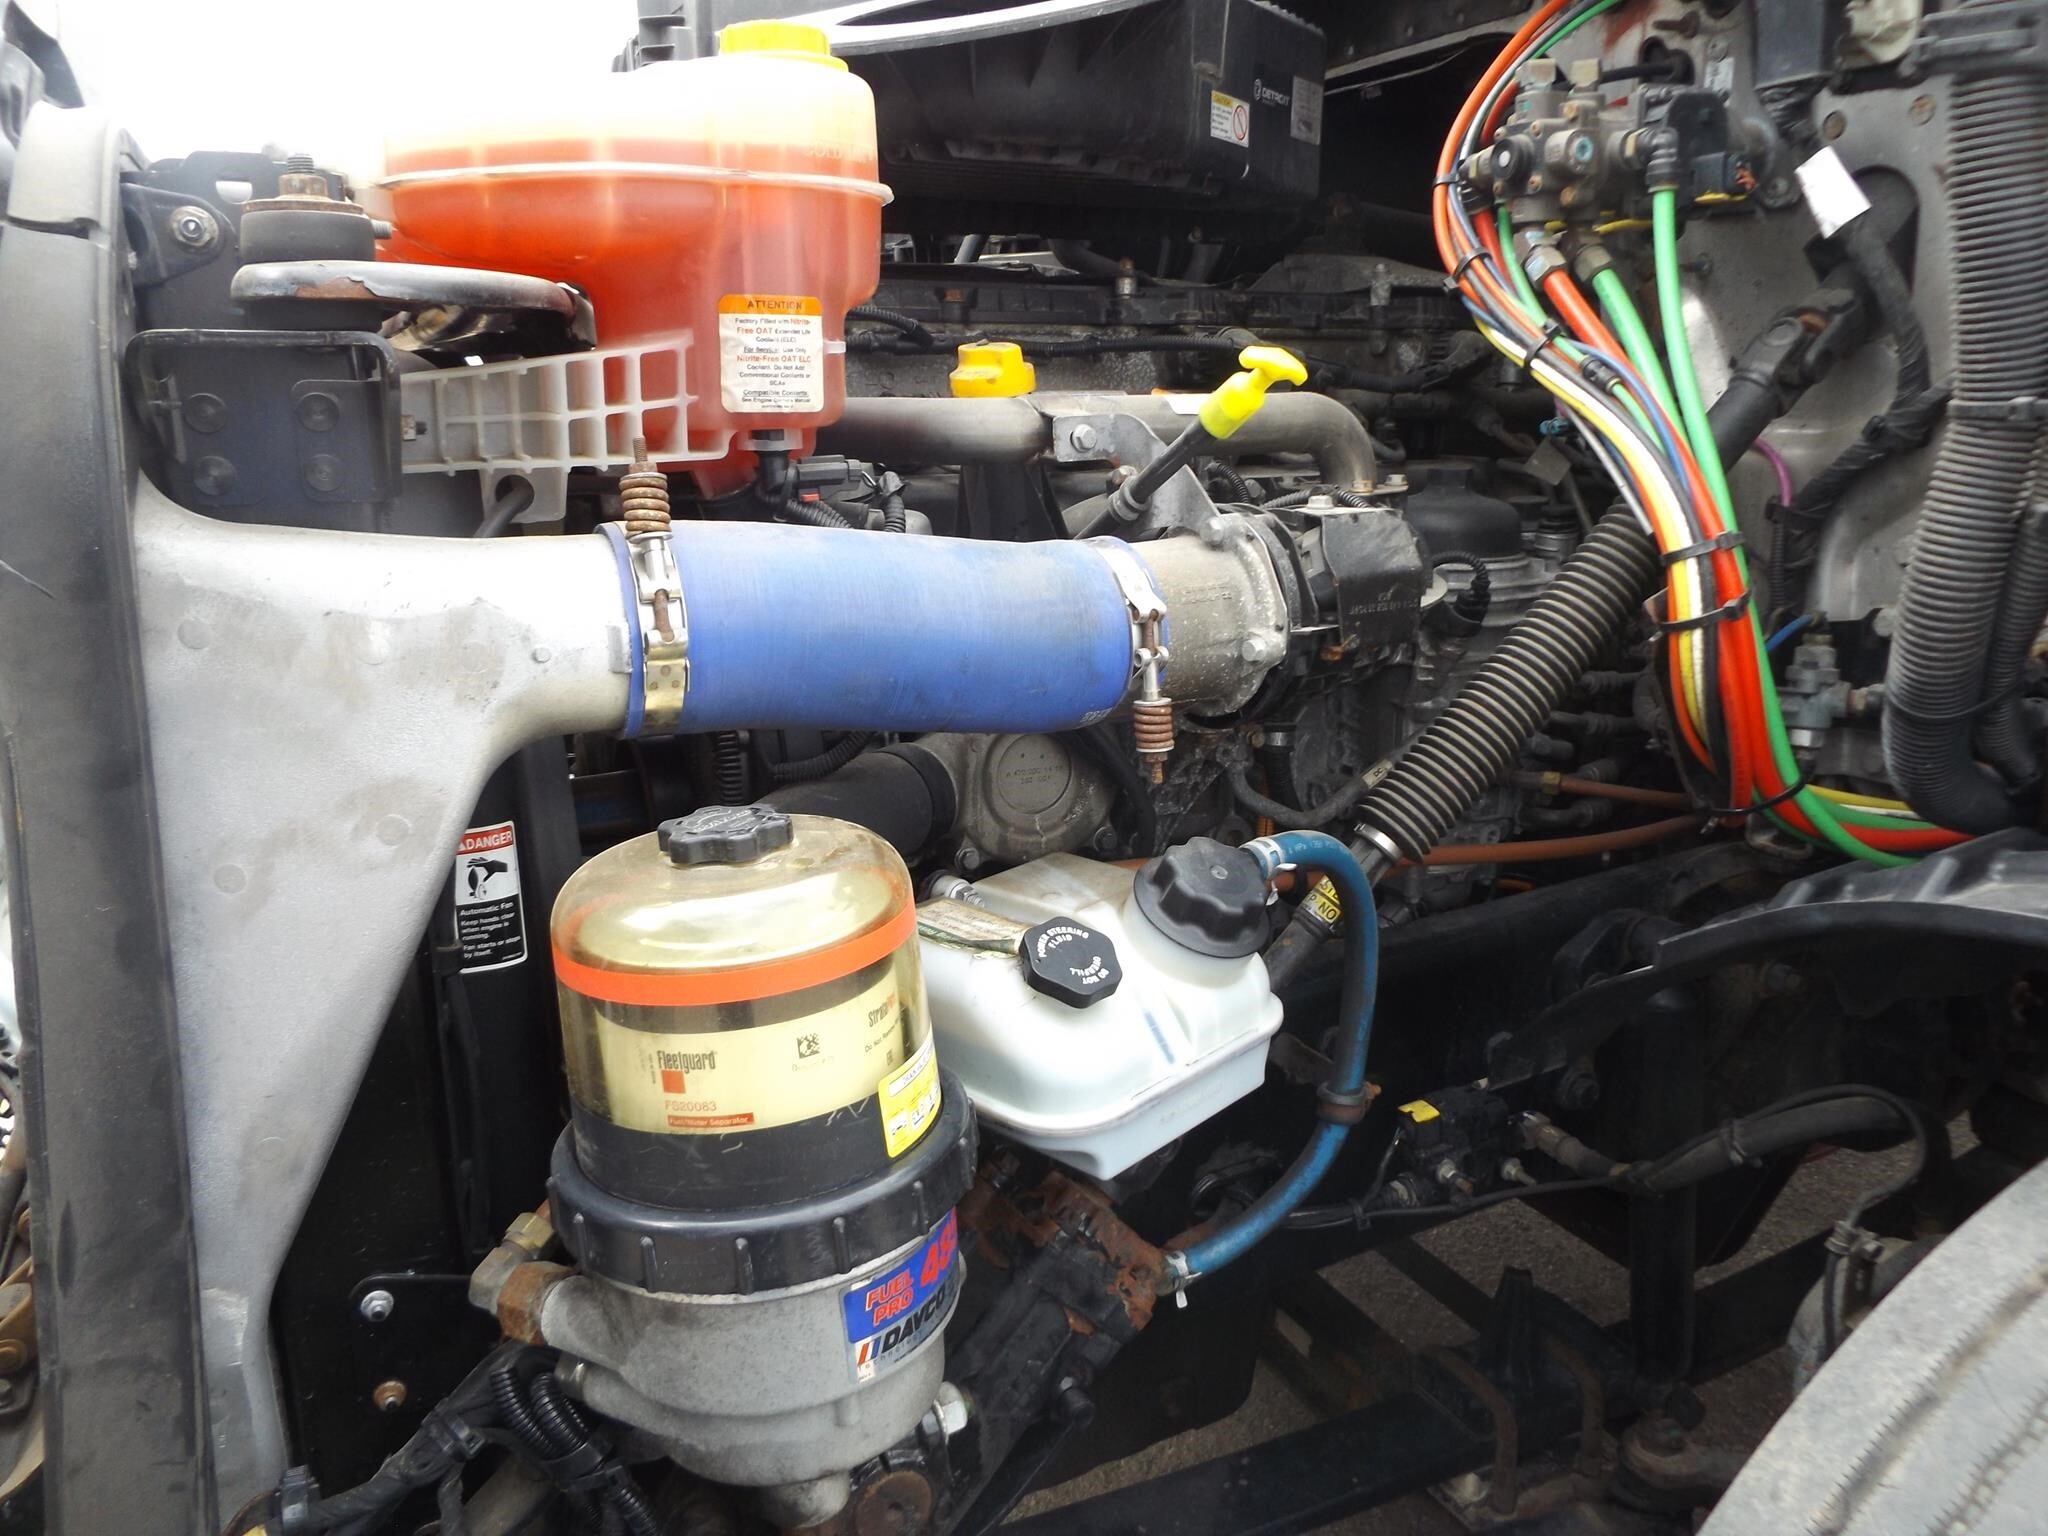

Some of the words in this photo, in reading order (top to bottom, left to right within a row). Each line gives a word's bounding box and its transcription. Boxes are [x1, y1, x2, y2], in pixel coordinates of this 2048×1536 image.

[1261, 87, 1290, 107] DETROIT
[747, 300, 802, 310] ATTENTION
[735, 317, 758, 325] Factory
[737, 326, 754, 334] Free
[756, 327, 773, 335] OAT
[737, 355, 779, 363] Nitrite-Free
[781, 355, 796, 363] OAT
[466, 831, 513, 851] DANGER
[460, 904, 500, 916] Automatic
[500, 912, 515, 920] clear
[1318, 901, 1337, 920] NO
[480, 923, 503, 931] engine
[477, 941, 497, 949] starts
[505, 935, 521, 944] stops
[1037, 933, 1050, 958] POWER
[1046, 926, 1089, 939] STEERING
[1047, 934, 1073, 949] FLUID
[1069, 955, 1102, 976] OVERFILL
[657, 1050, 717, 1074] Fleetguard
[865, 1269, 913, 1312] FUEL
[873, 1290, 914, 1327] PRO
[881, 1285, 946, 1354] DAVCO
